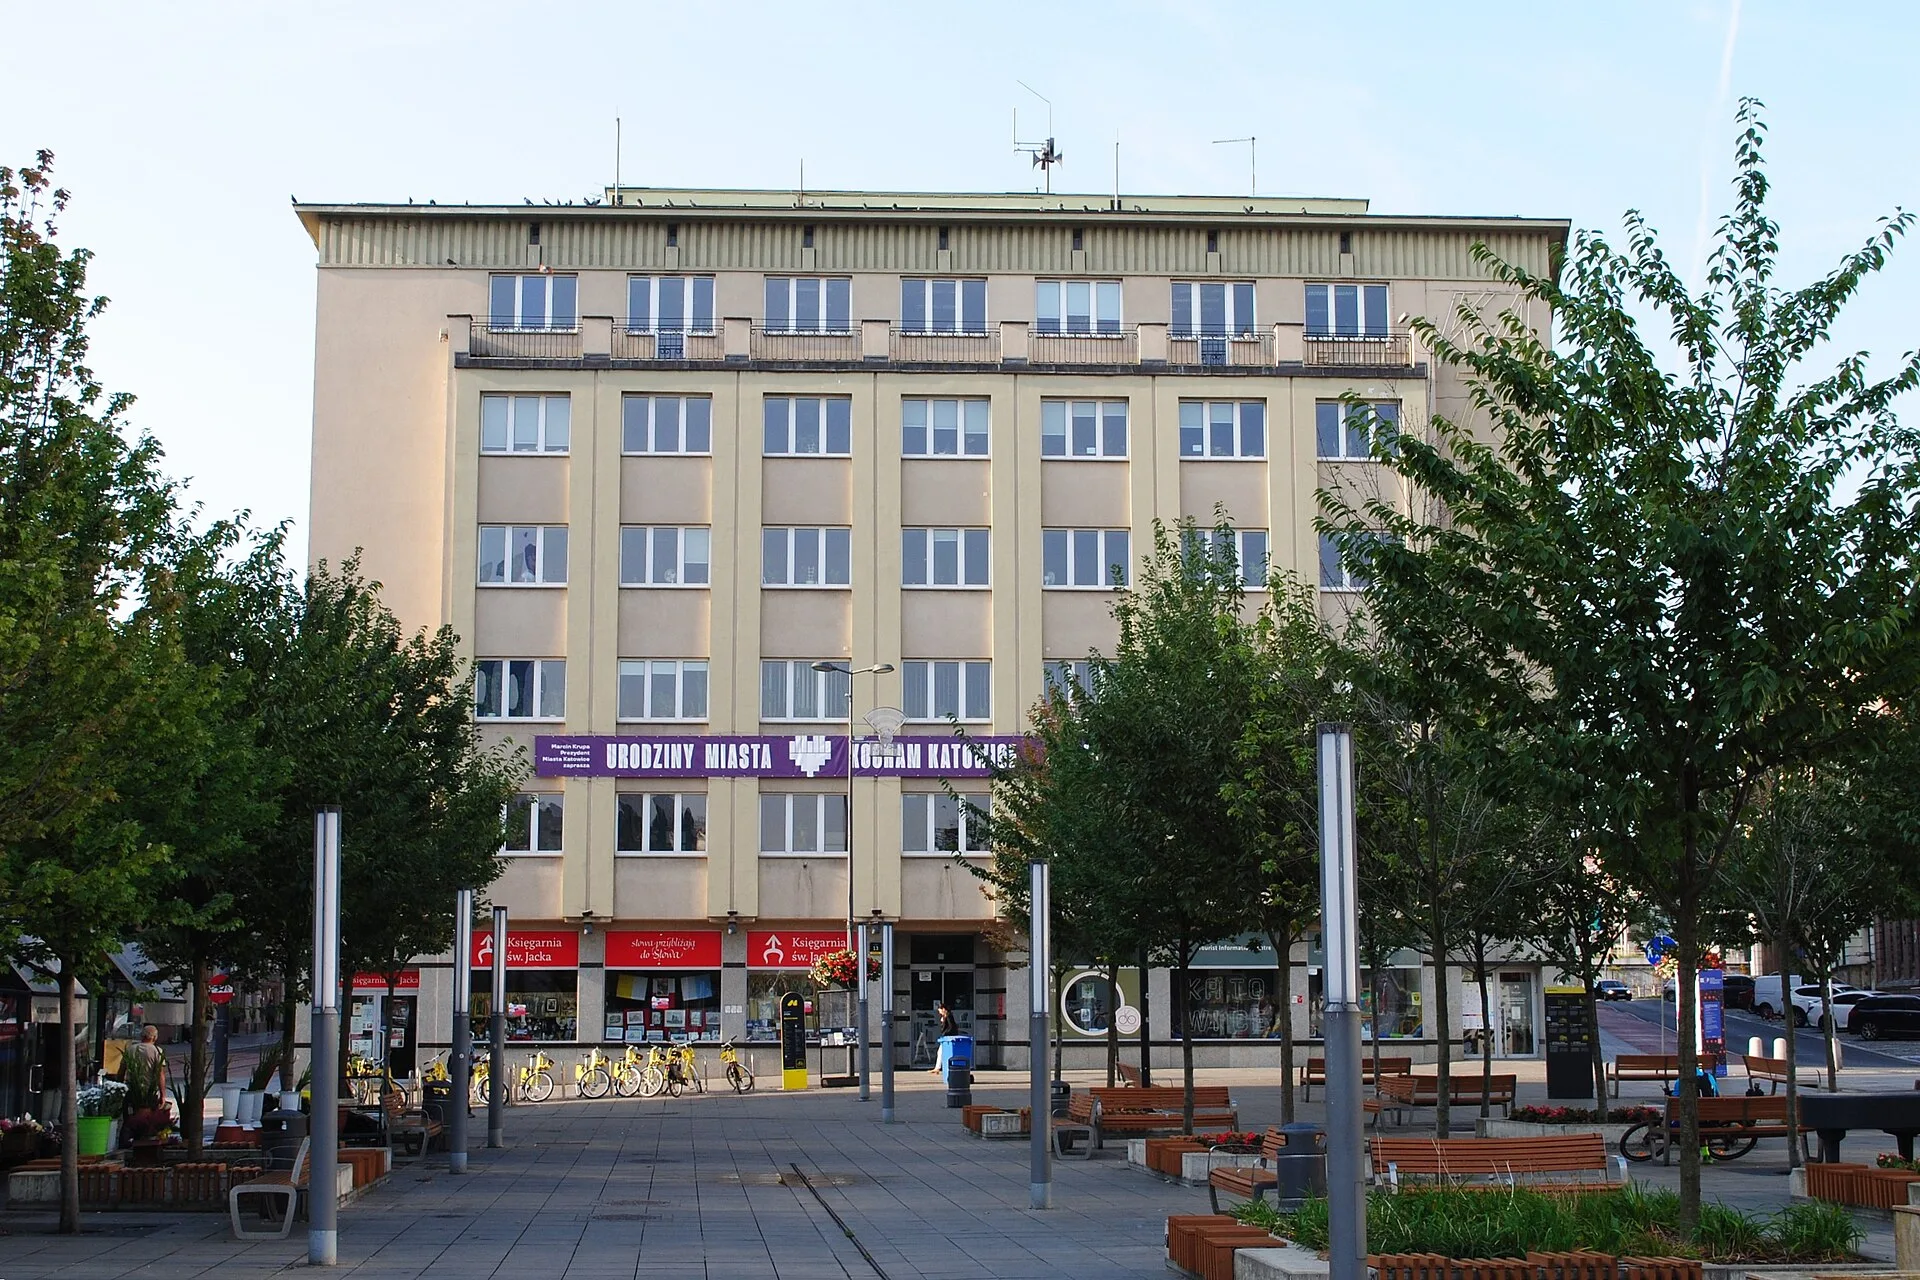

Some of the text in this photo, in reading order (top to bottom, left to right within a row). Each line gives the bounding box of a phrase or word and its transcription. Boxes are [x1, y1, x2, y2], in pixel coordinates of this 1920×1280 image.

[606, 743, 695, 769] URODZINY
[705, 743, 772, 769] MIASTA
[507, 937, 562, 949] Księgarnia
[791, 937, 846, 950] Księgarnia
[507, 951, 552, 963] św. Jacka
[791, 951, 808, 962] św.
[399, 976, 419, 985] Jacka
